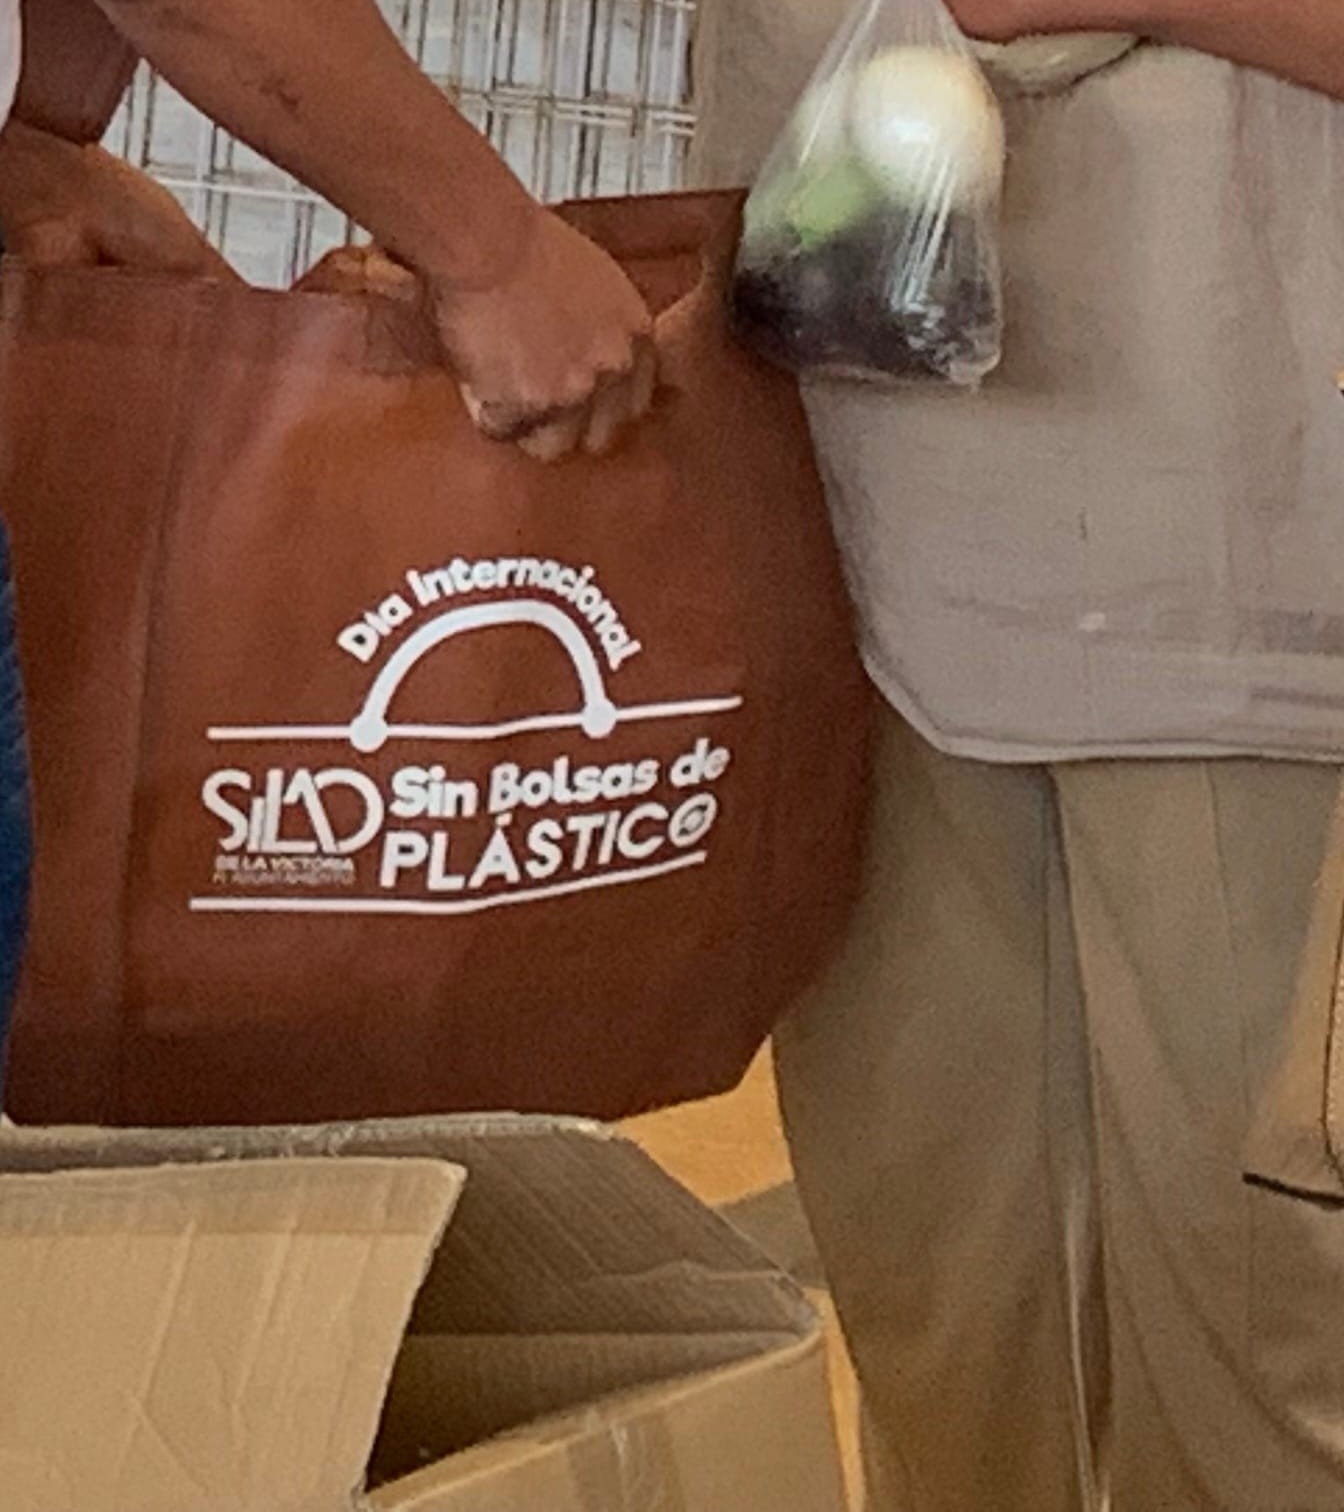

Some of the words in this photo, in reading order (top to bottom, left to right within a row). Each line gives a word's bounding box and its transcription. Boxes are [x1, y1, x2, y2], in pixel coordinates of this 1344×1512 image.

[405, 557, 643, 672] Internacional
[389, 764, 480, 818] Sin
[488, 754, 661, 814] Bolsas
[679, 736, 732, 788] de
[379, 791, 719, 892] PLÁSTICO
